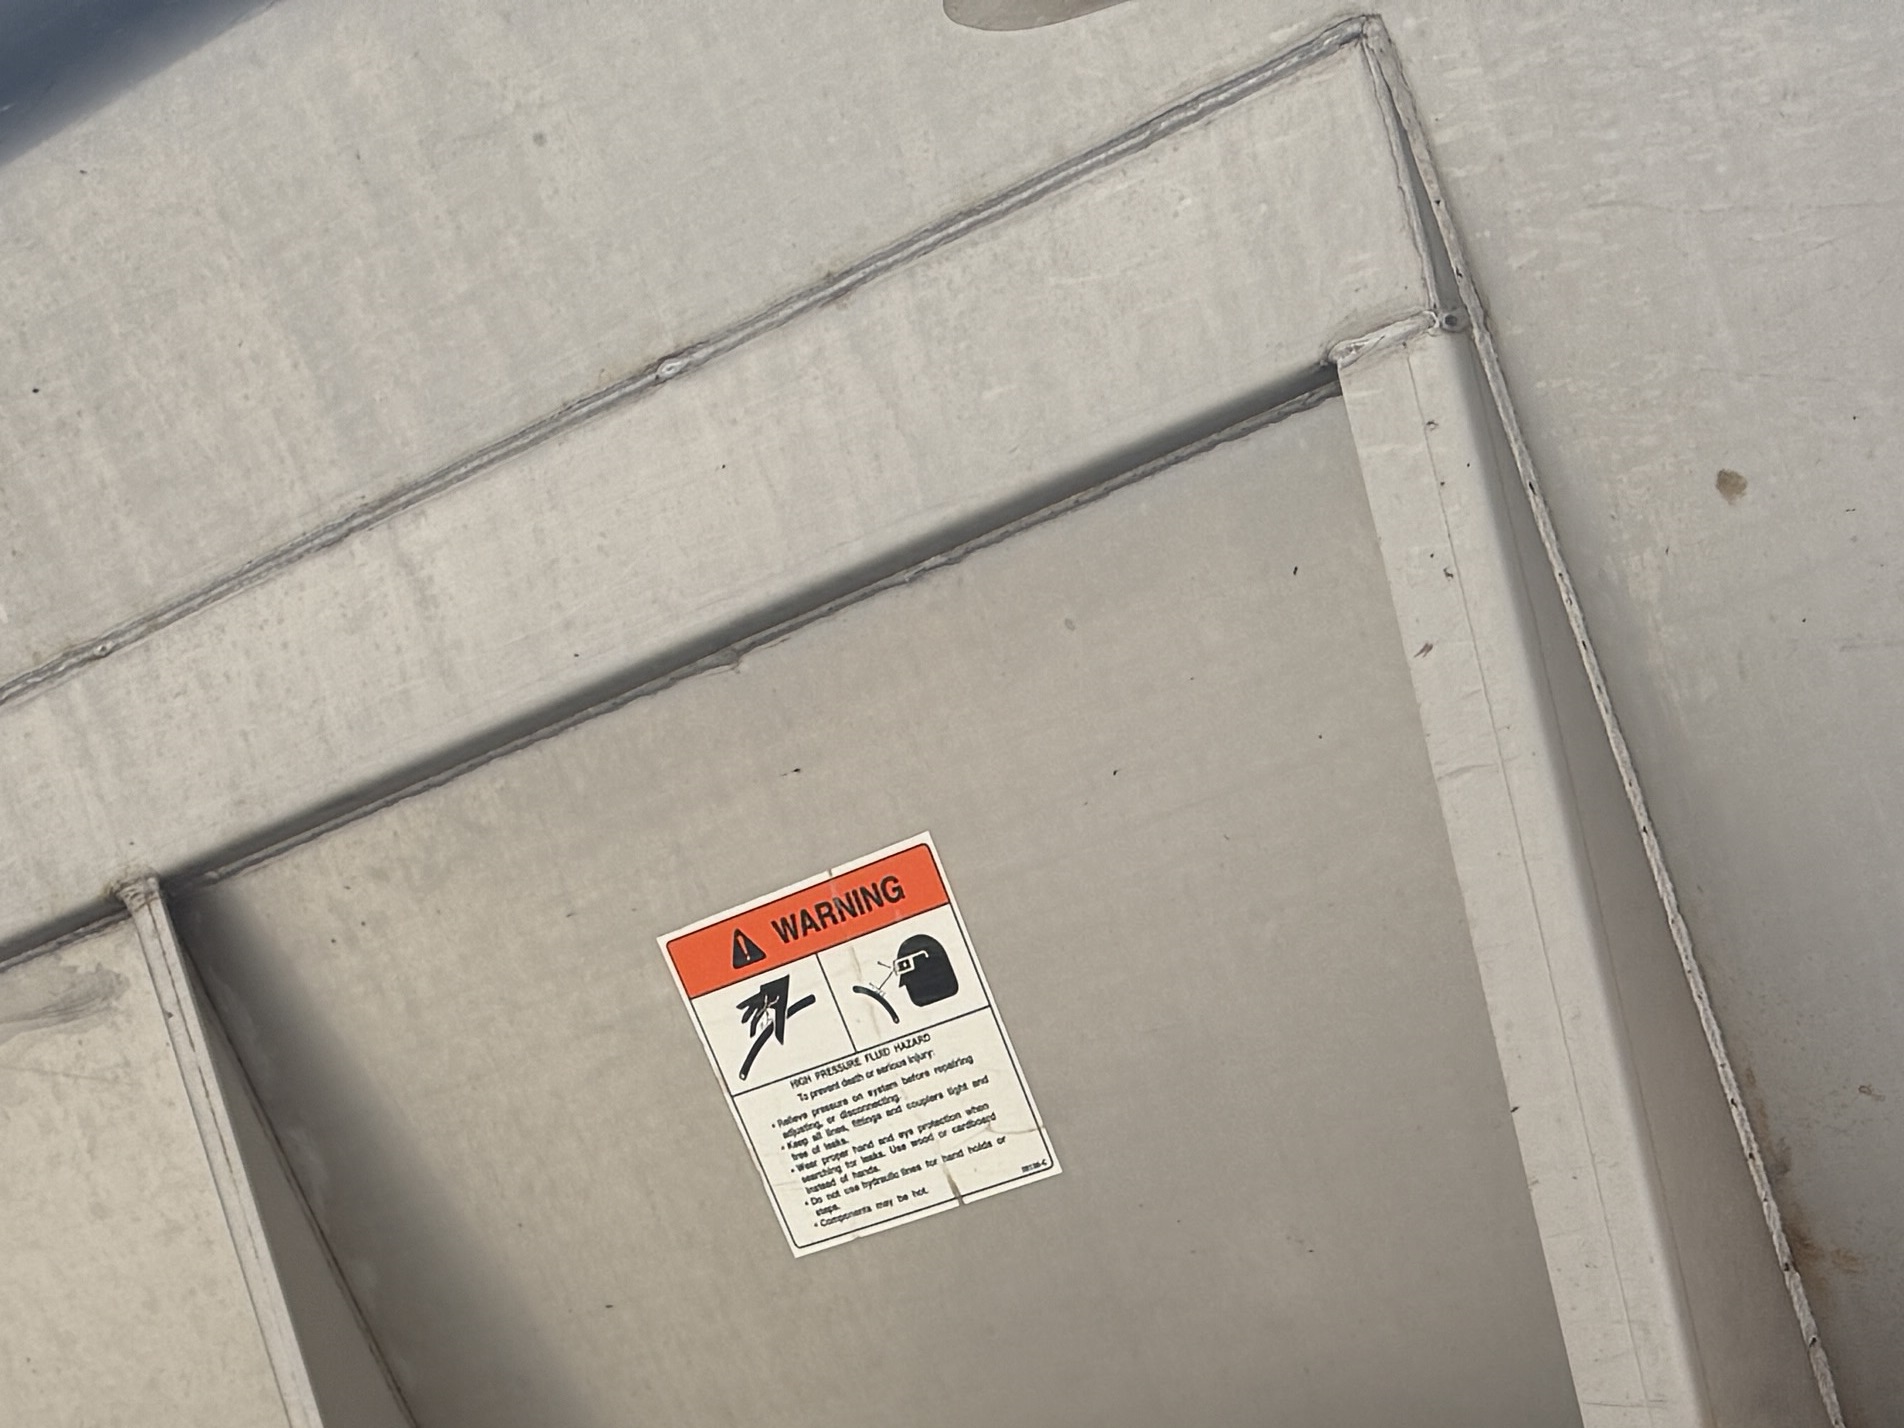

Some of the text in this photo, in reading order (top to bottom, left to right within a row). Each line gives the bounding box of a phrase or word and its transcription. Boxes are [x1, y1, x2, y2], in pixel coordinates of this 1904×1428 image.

[770, 875, 906, 944] WARNING
[789, 1033, 930, 1088] HIGH PRESSURE FLUID HAZARD
[865, 1069, 874, 1078] or
[876, 1059, 906, 1074] serious
[811, 1098, 848, 1117] pressure
[851, 1092, 863, 1102] on
[867, 1081, 898, 1096] system
[900, 1070, 930, 1084] before
[786, 1137, 808, 1149] Keep
[885, 1104, 902, 1116] and
[971, 1074, 988, 1087] and
[826, 1115, 835, 1124] or
[811, 1144, 820, 1154] of
[821, 1149, 848, 1165] proper
[851, 1140, 874, 1153] hand
[877, 1133, 894, 1145] and
[917, 1112, 961, 1133] protection
[888, 1143, 906, 1153] Use
[937, 1129, 946, 1138] or
[810, 1196, 823, 1205] Do
[826, 1189, 840, 1200] not
[924, 1158, 937, 1167] for
[996, 1135, 1005, 1144] or
[839, 1173, 848, 1183] of
[896, 1193, 908, 1202] be
